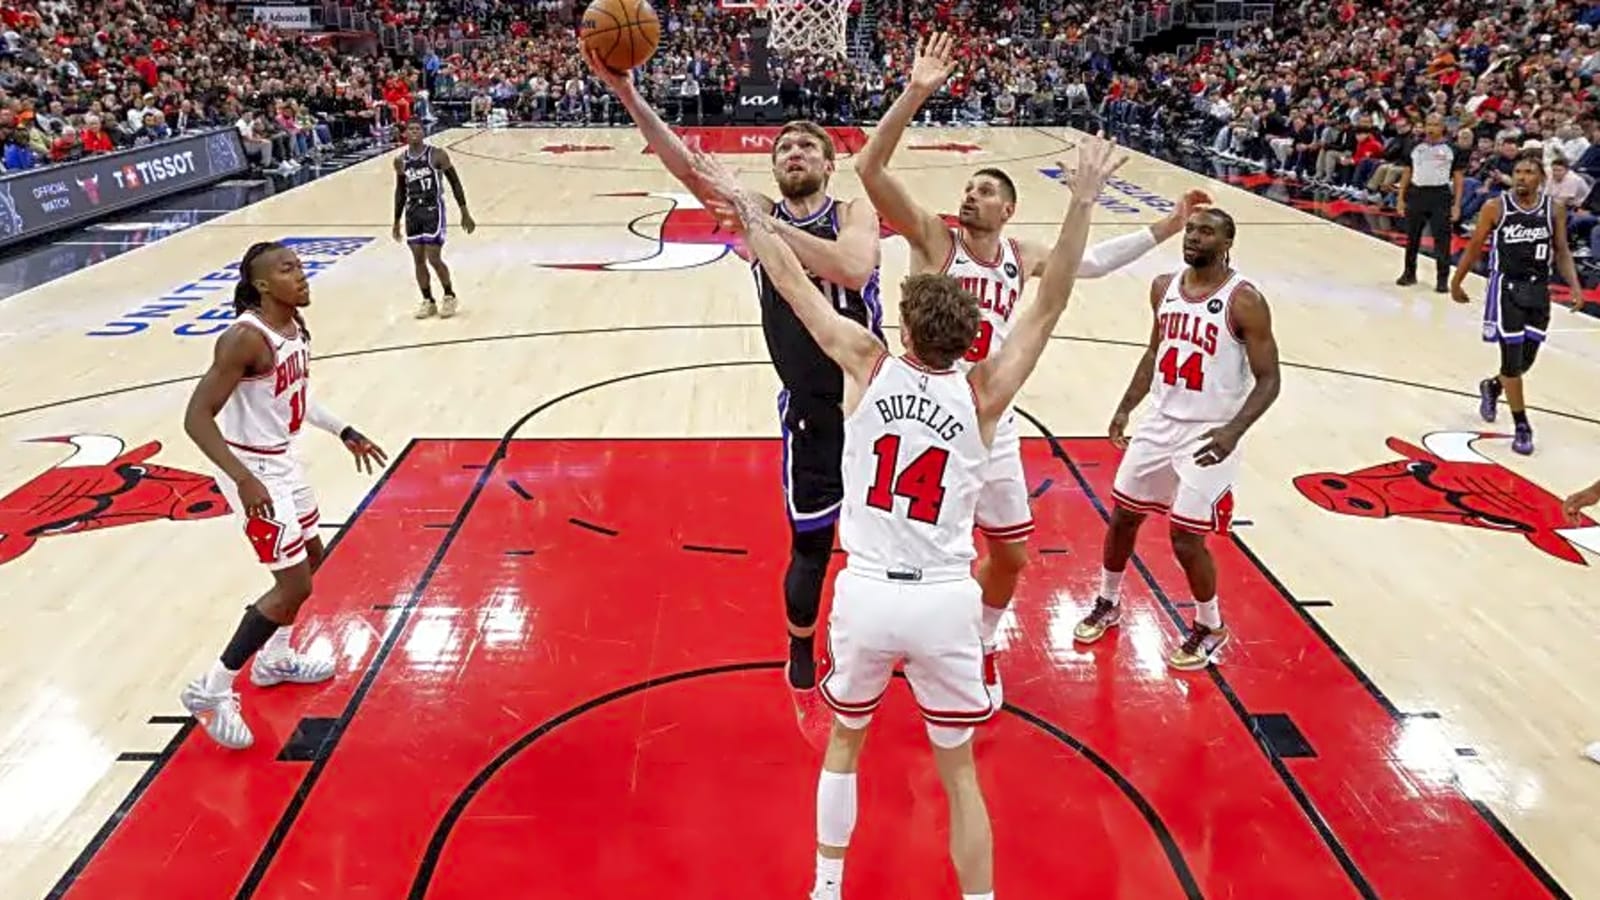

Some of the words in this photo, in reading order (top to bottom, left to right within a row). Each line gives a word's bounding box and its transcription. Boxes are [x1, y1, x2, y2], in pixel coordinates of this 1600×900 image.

[136, 151, 195, 185] TISSOT
[32, 180, 69, 199] OFFICIAL
[420, 177, 432, 191] 17
[41, 198, 71, 214] WATCH
[1535, 243, 1548, 260] 0
[1158, 346, 1204, 391] 44
[875, 395, 964, 442] BUZELIS
[866, 433, 949, 525] 14
